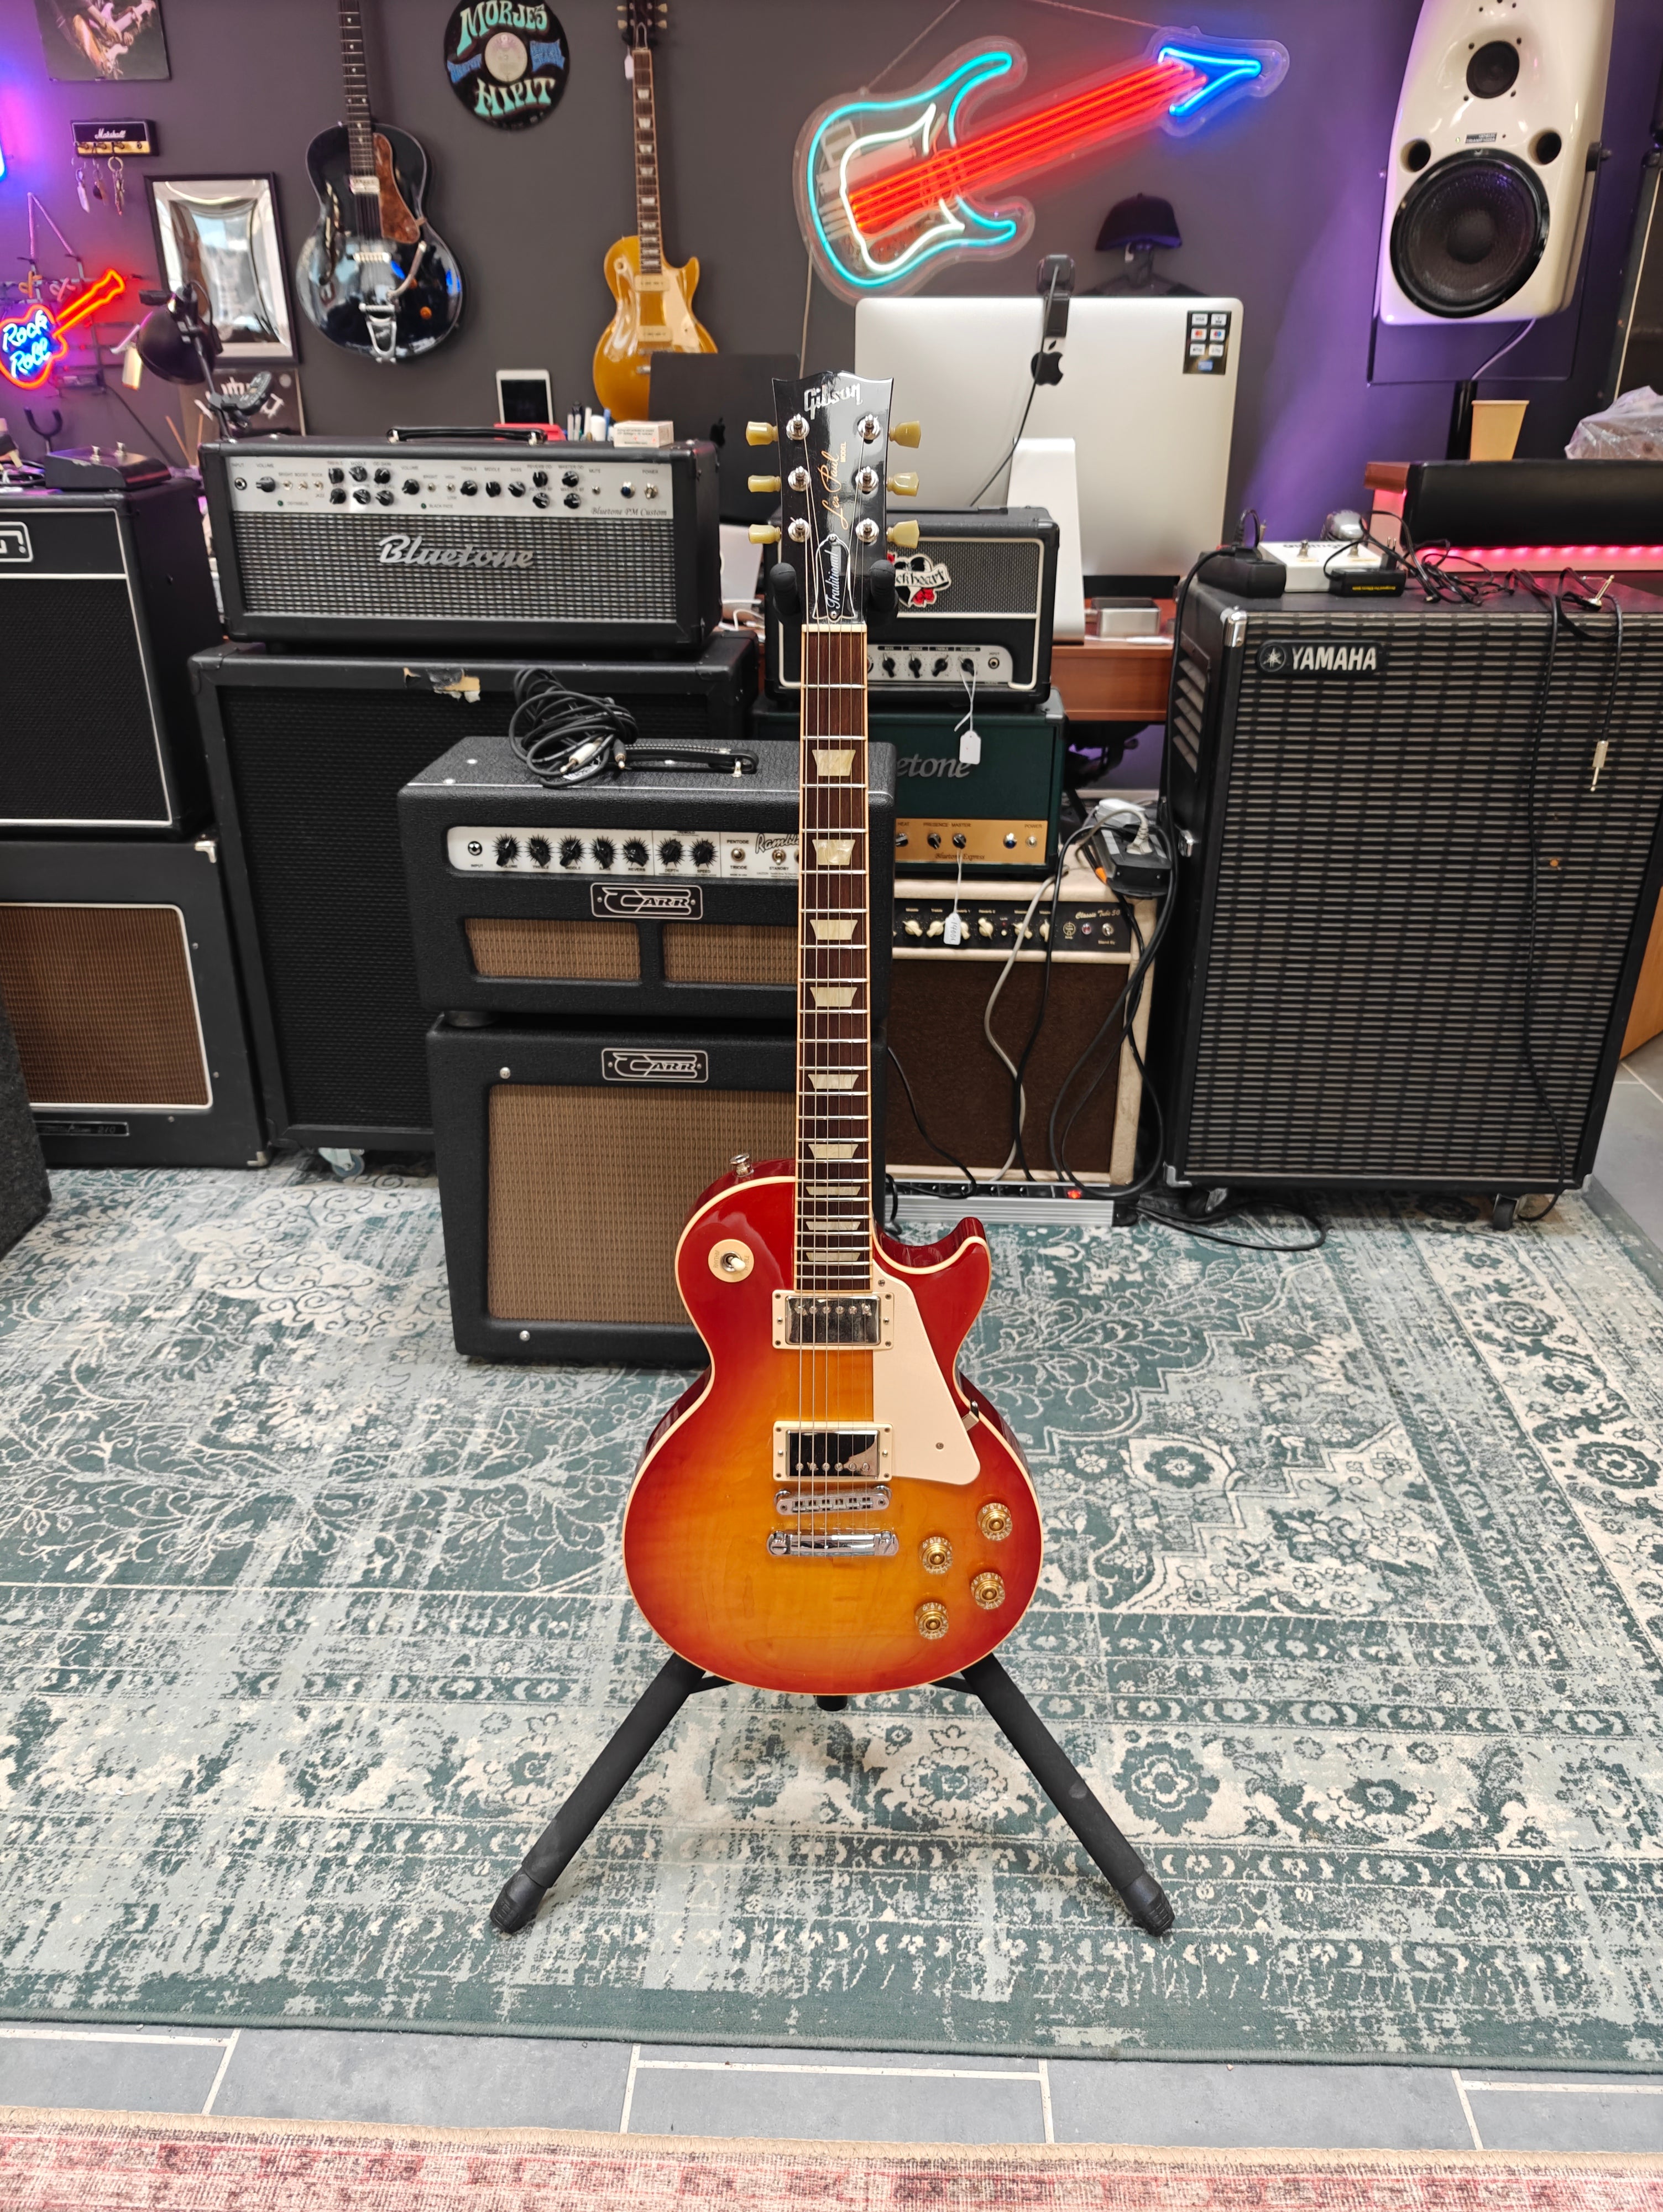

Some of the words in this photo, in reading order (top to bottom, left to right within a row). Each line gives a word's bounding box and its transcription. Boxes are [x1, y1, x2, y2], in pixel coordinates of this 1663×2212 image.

[457, 1, 547, 56] MORJES
[95, 128, 126, 139] Marshall
[2, 310, 48, 352] Rock
[9, 337, 51, 379] Roll
[804, 383, 863, 420] Gibson
[818, 450, 841, 493] Paul
[592, 505, 622, 515] Bluetone
[625, 508, 639, 516] PM
[822, 495, 848, 530] Les
[379, 535, 535, 568] Bluetone
[824, 550, 840, 609] Traditional
[896, 570, 945, 585] ckheart
[1292, 646, 1376, 670] YAMAHA
[897, 753, 971, 778] etone
[602, 887, 691, 915] CARR
[1075, 911, 1096, 920] Classic
[612, 1052, 697, 1078] CARR
